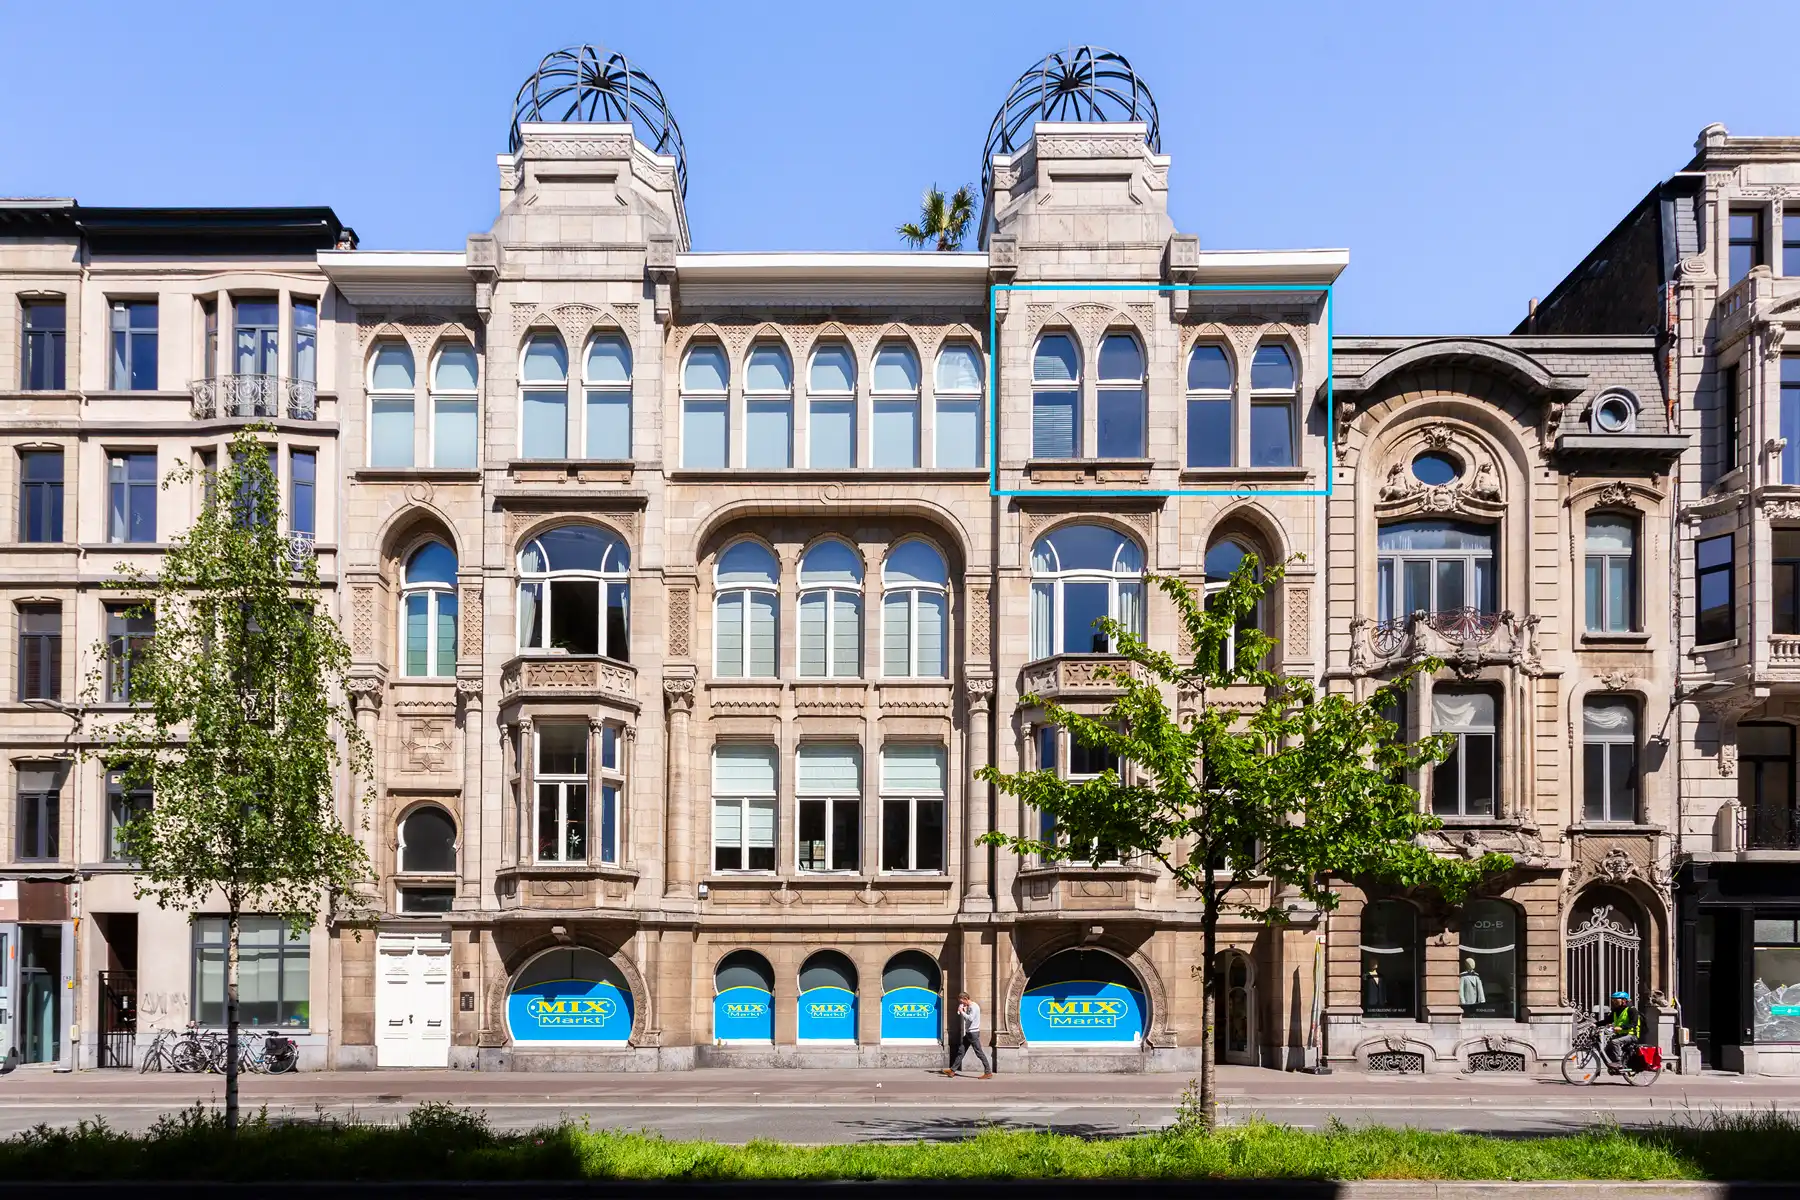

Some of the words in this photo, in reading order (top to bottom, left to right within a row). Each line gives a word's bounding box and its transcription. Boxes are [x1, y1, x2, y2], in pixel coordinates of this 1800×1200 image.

[536, 1001, 608, 1013] MIX
[727, 1004, 764, 1012] MIX
[811, 1004, 847, 1012] MIX
[893, 1004, 930, 1012] MIX
[1047, 1001, 1120, 1014] MIX
[542, 1016, 601, 1024] Markt
[1053, 1017, 1113, 1025] Markt
